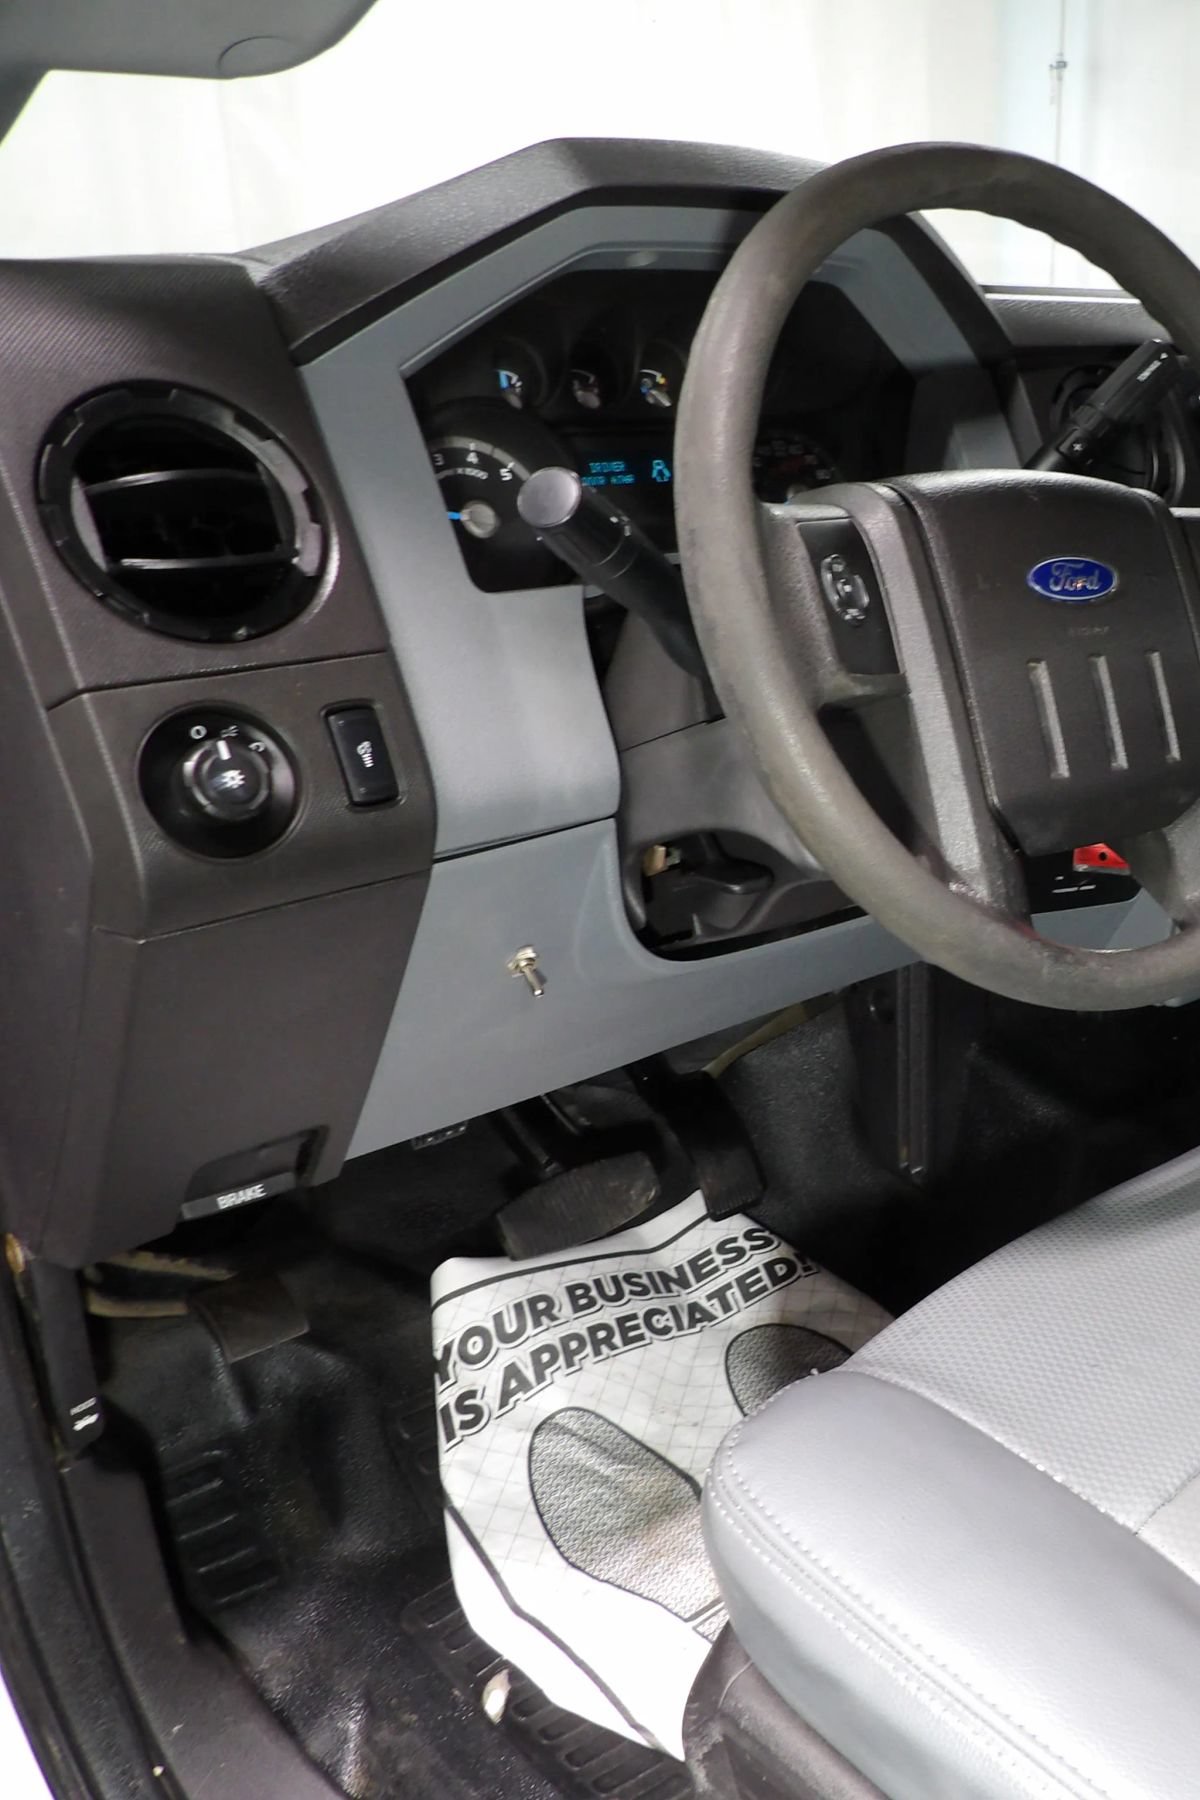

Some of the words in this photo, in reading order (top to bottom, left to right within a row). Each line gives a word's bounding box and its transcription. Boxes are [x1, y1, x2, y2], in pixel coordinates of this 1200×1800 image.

[466, 451, 479, 464] 4
[500, 468, 512, 481] 5
[1049, 562, 1101, 592] Ford
[216, 1184, 267, 1210] BRAKE
[433, 1291, 564, 1387] YOUR
[562, 1226, 778, 1317] BUSINESS
[438, 1386, 491, 1447] IS
[494, 1252, 818, 1416] APPRECIATED!
